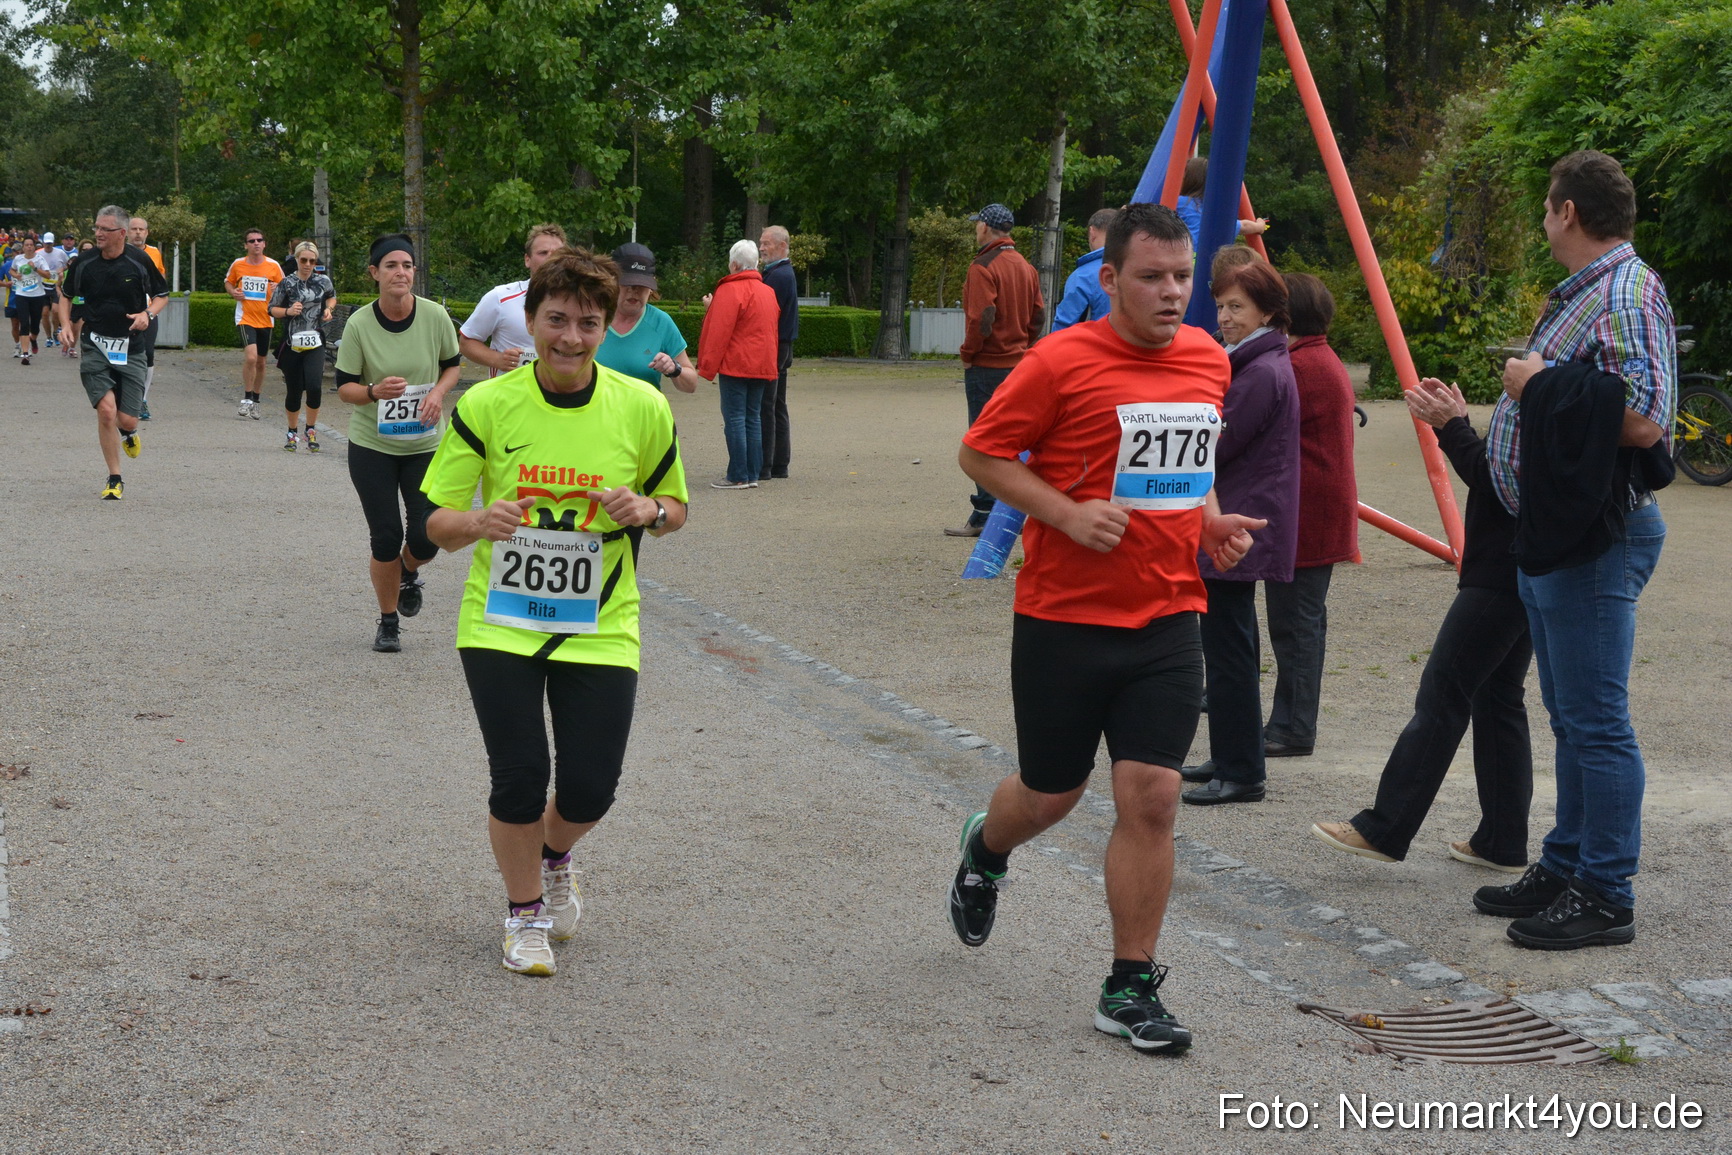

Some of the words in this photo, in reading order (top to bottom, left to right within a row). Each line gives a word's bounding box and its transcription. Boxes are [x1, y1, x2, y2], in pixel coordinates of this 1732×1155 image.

[243, 281, 266, 291] 3319
[299, 336, 316, 347] 133
[384, 398, 420, 420] 257
[1122, 414, 1158, 424] PARTL
[1160, 413, 1205, 423] Neumarkt
[392, 425, 425, 434] Stefanie
[1128, 428, 1211, 468] 2178
[517, 463, 604, 488] Müller
[1145, 479, 1190, 495] Florian
[533, 539, 585, 552] Neumarkt
[501, 550, 592, 594] 2630
[528, 601, 556, 618] Rita
